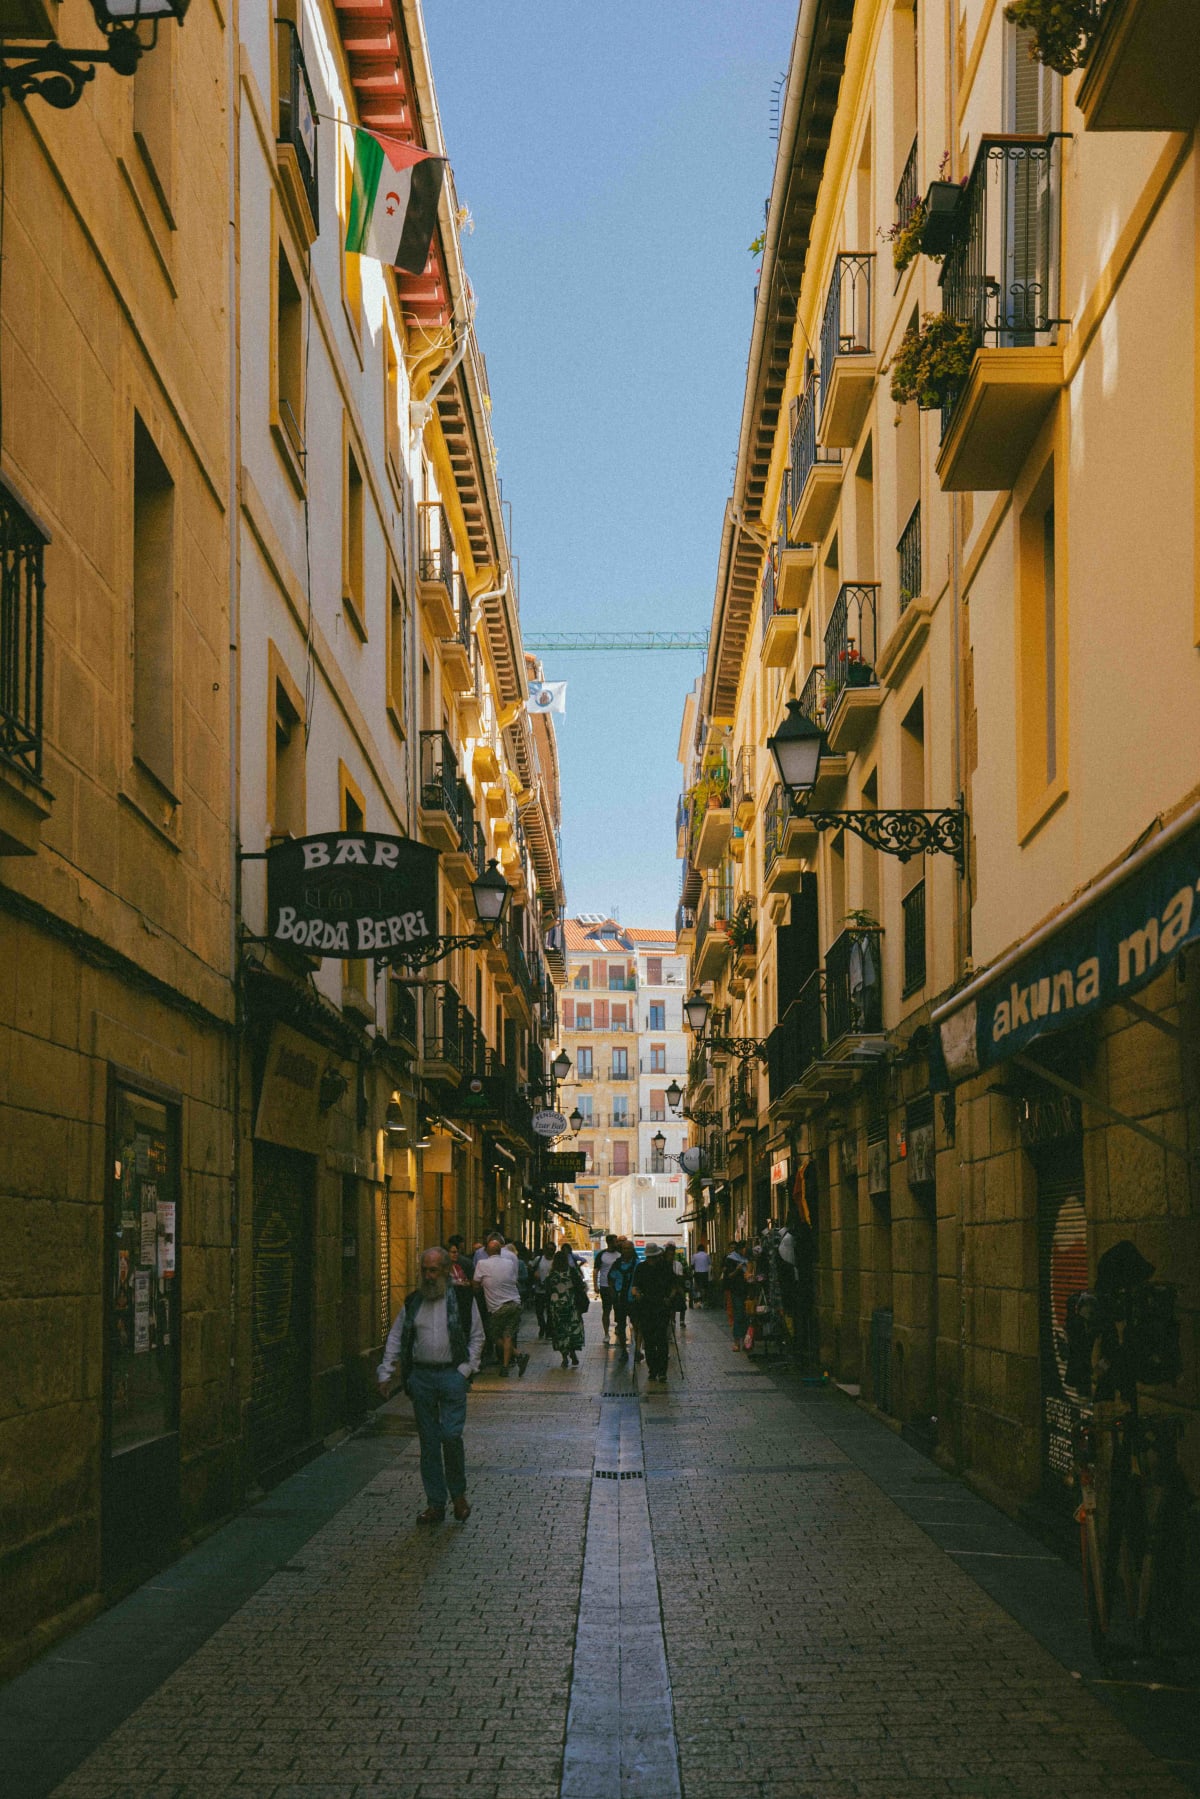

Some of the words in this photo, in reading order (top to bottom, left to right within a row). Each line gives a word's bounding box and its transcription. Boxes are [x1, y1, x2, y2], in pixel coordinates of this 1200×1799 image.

[302, 839, 400, 870] BAR
[274, 906, 350, 950] BORDA
[992, 956, 1100, 1043] akuna
[1118, 878, 1200, 987] ma
